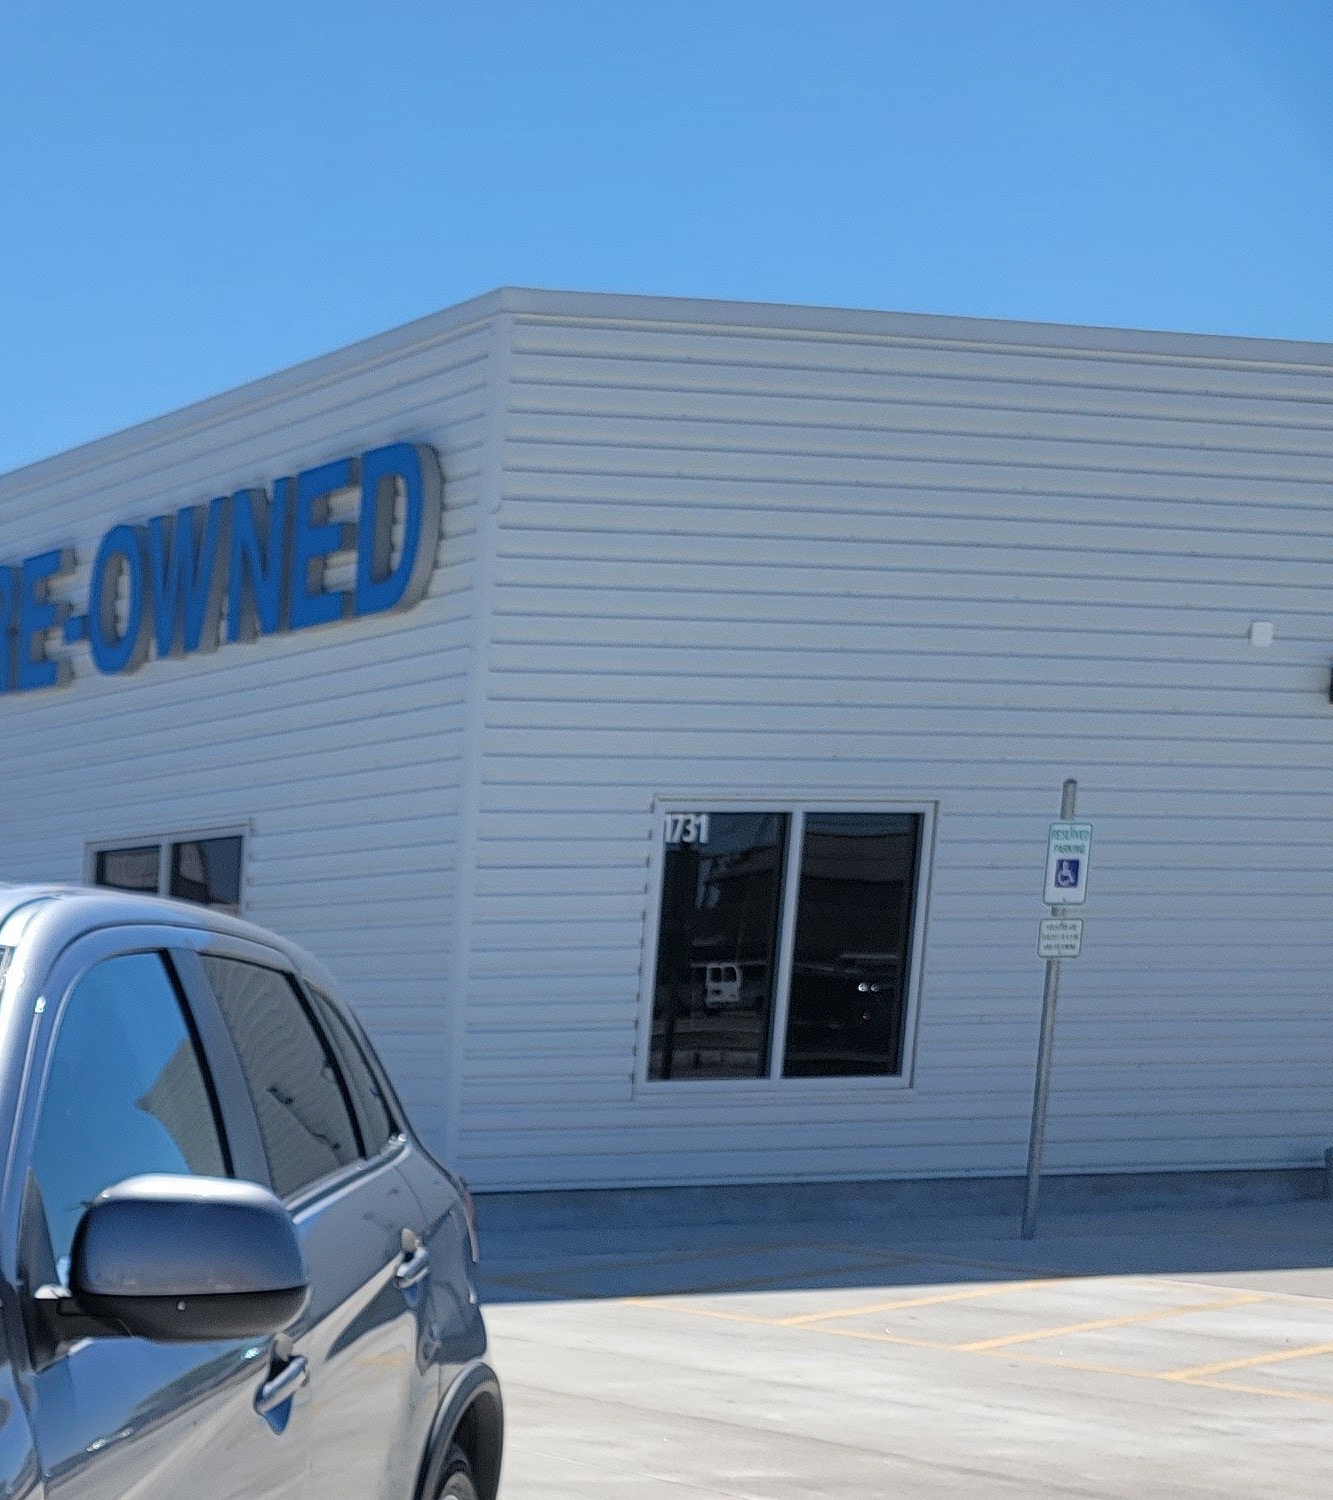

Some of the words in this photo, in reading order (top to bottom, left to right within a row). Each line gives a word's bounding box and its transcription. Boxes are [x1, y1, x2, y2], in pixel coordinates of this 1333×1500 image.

[665, 814, 709, 844] 1731
[1050, 829, 1090, 841] RESERVED
[1053, 844, 1085, 855] PARKING
